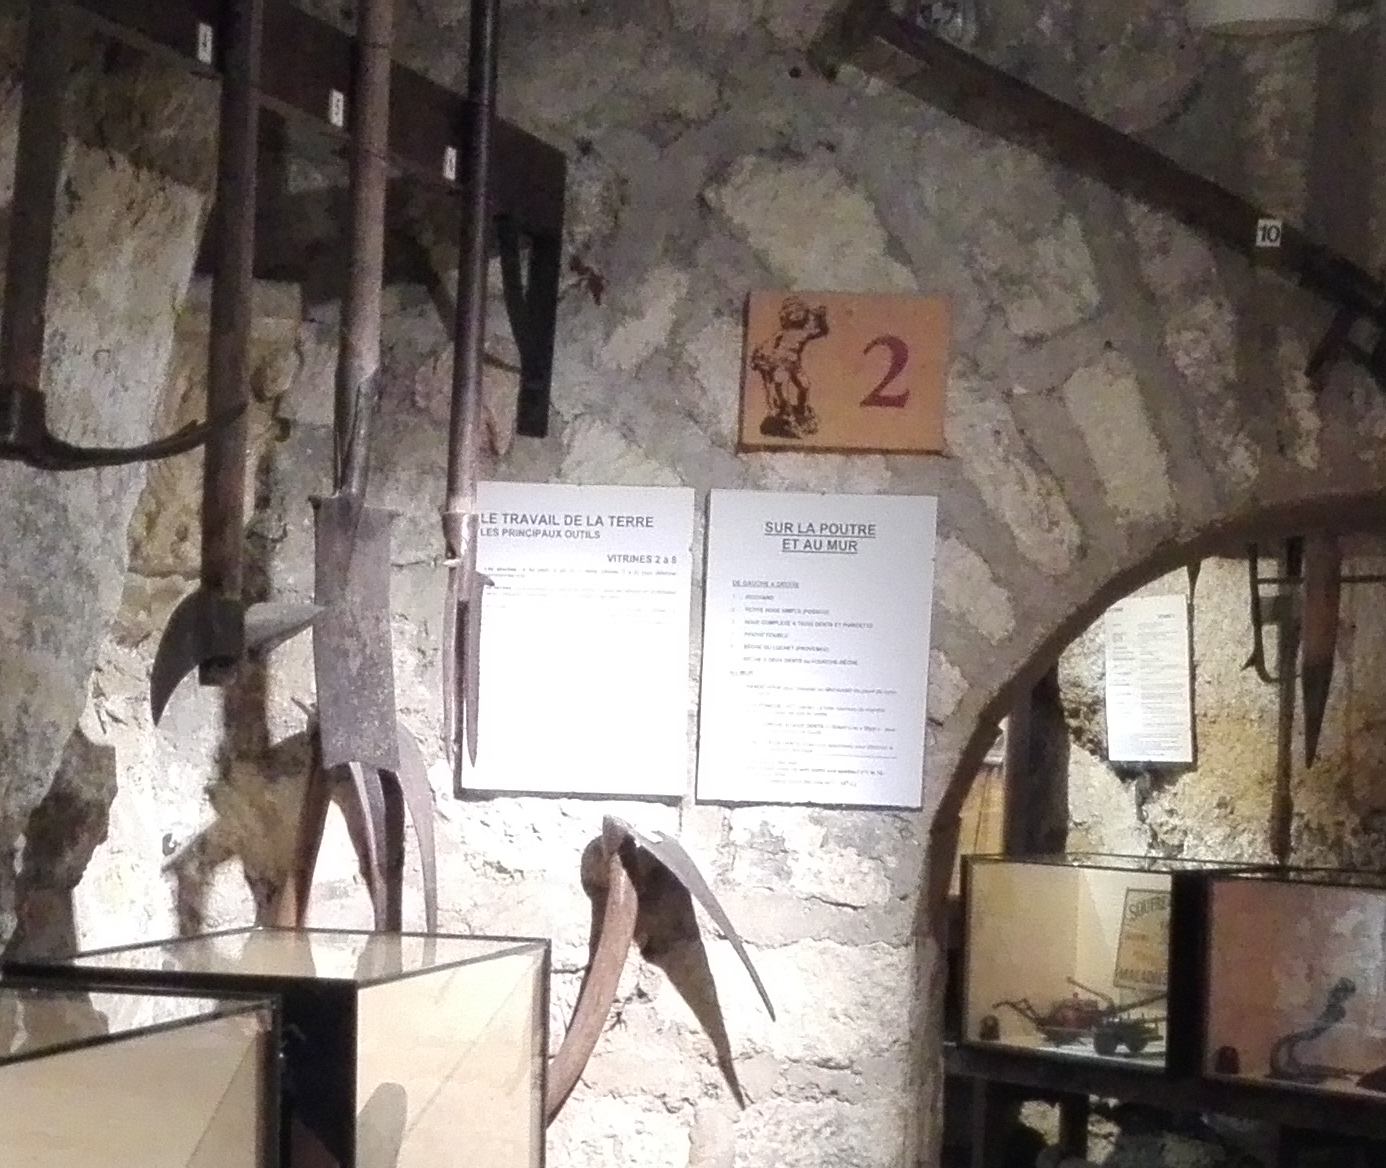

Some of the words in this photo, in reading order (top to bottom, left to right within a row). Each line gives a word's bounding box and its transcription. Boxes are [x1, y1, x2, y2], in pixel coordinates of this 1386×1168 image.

[1259, 223, 1281, 243] 10
[859, 333, 911, 408] 2
[480, 512, 498, 524] LE
[502, 513, 560, 526] TRAVAIL
[564, 514, 583, 526] DE
[586, 515, 604, 527] LA
[608, 515, 654, 528] TERRE
[480, 528, 499, 537] LES
[502, 528, 562, 538] PRINCIPAUX
[564, 529, 601, 539] OUTILS
[764, 521, 794, 533] SUR
[798, 522, 816, 534] LA
[819, 523, 877, 535] POUTRE
[782, 538, 800, 550] ET
[803, 539, 823, 551] AU
[827, 540, 859, 551] MUR
[606, 554, 652, 564] VITRINES
[654, 555, 661, 564] 2
